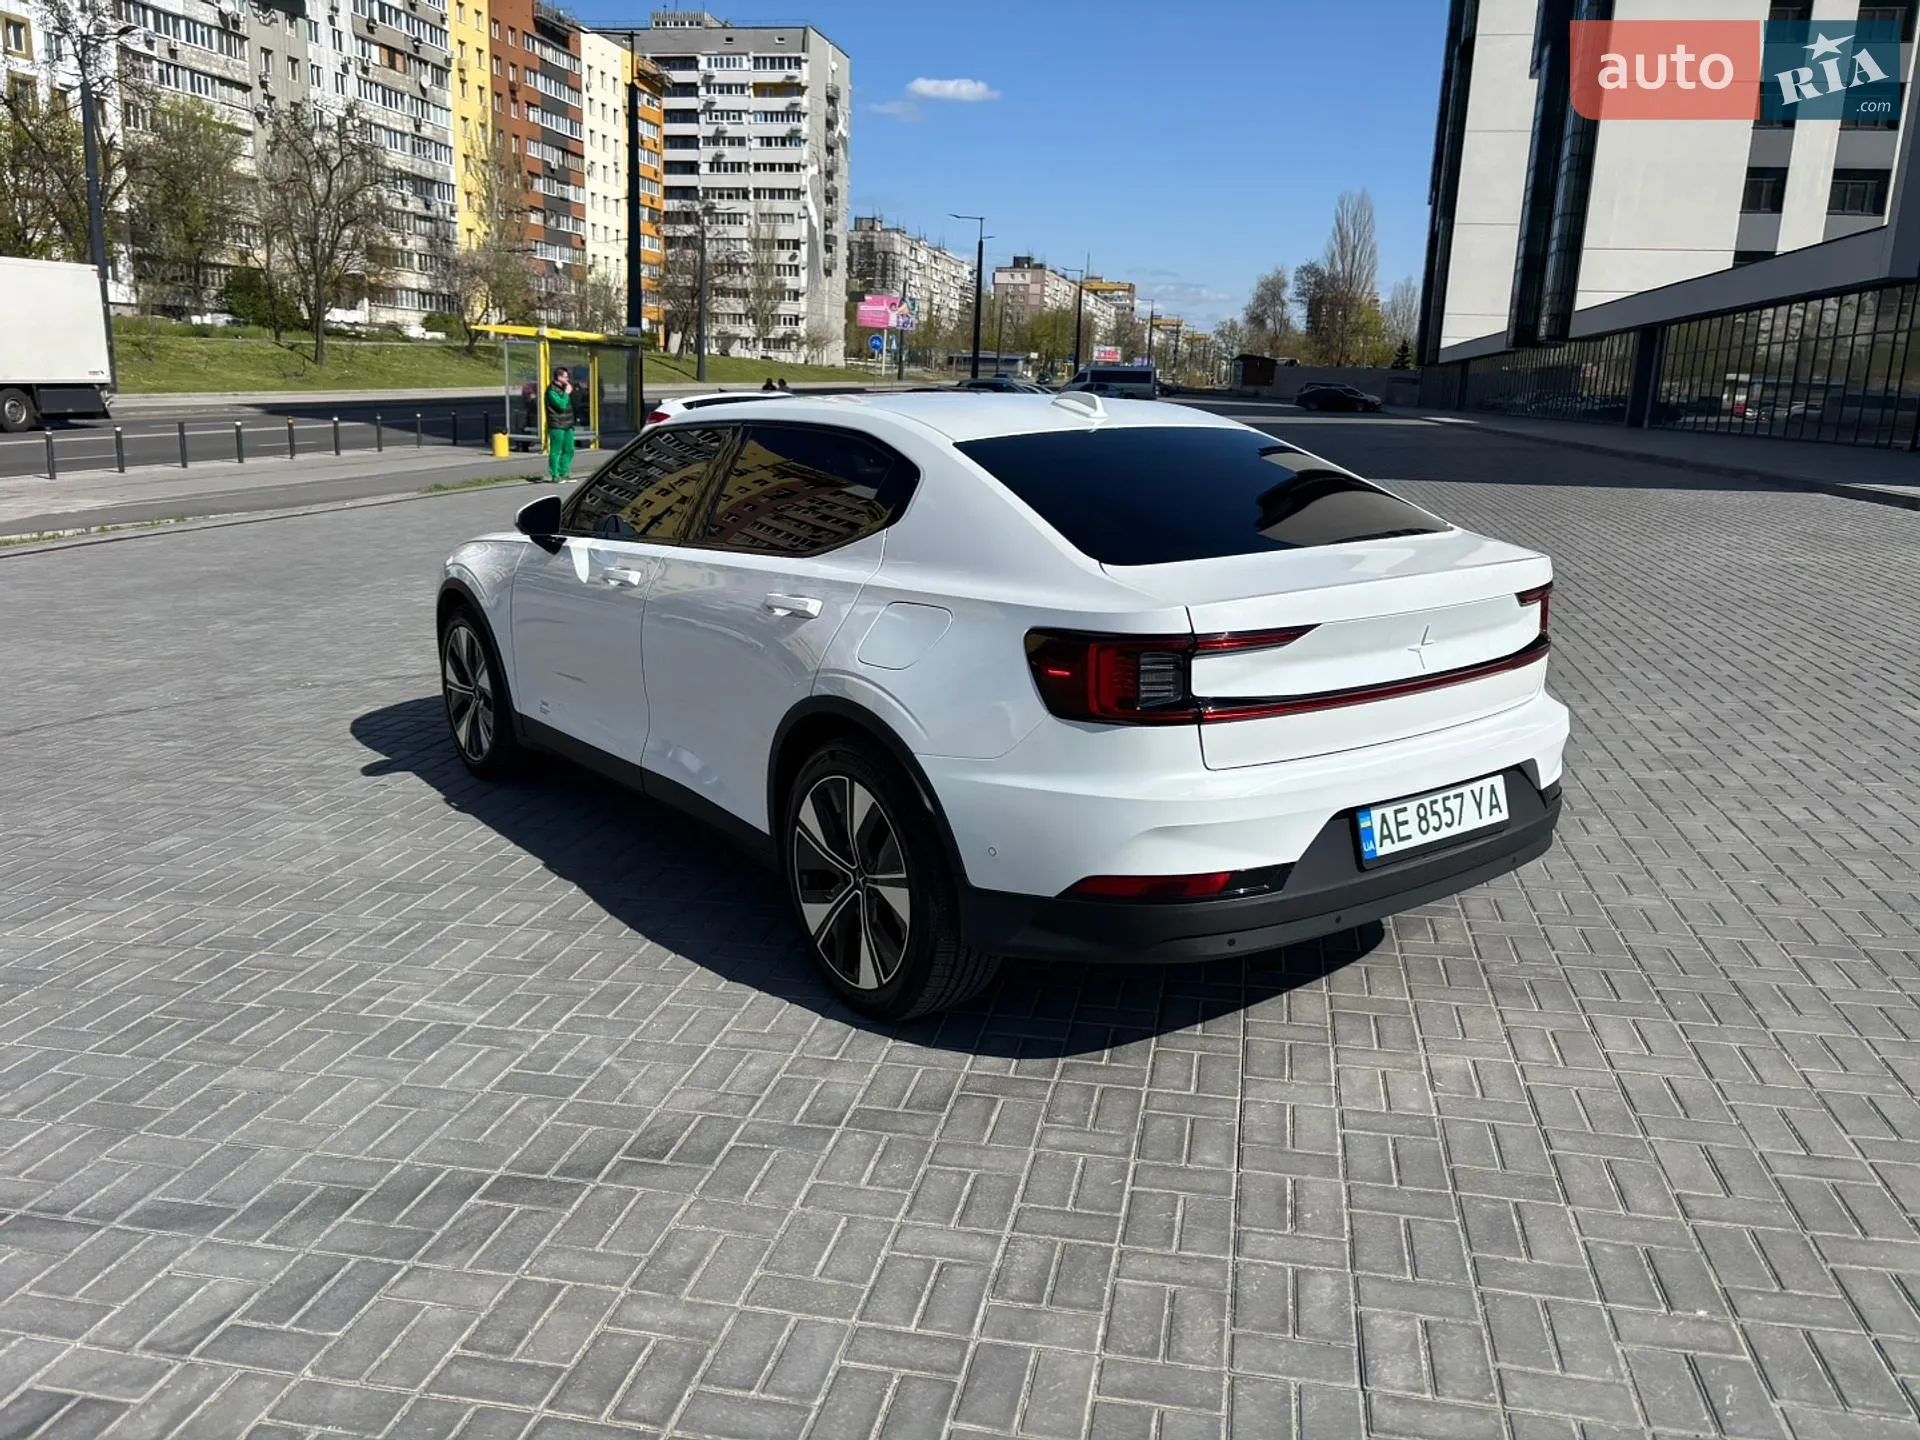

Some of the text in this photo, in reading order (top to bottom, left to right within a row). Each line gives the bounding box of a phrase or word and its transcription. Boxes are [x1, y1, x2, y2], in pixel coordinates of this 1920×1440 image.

[1379, 784, 1503, 848] AE 8557 YA
[1362, 841, 1375, 852] UA
